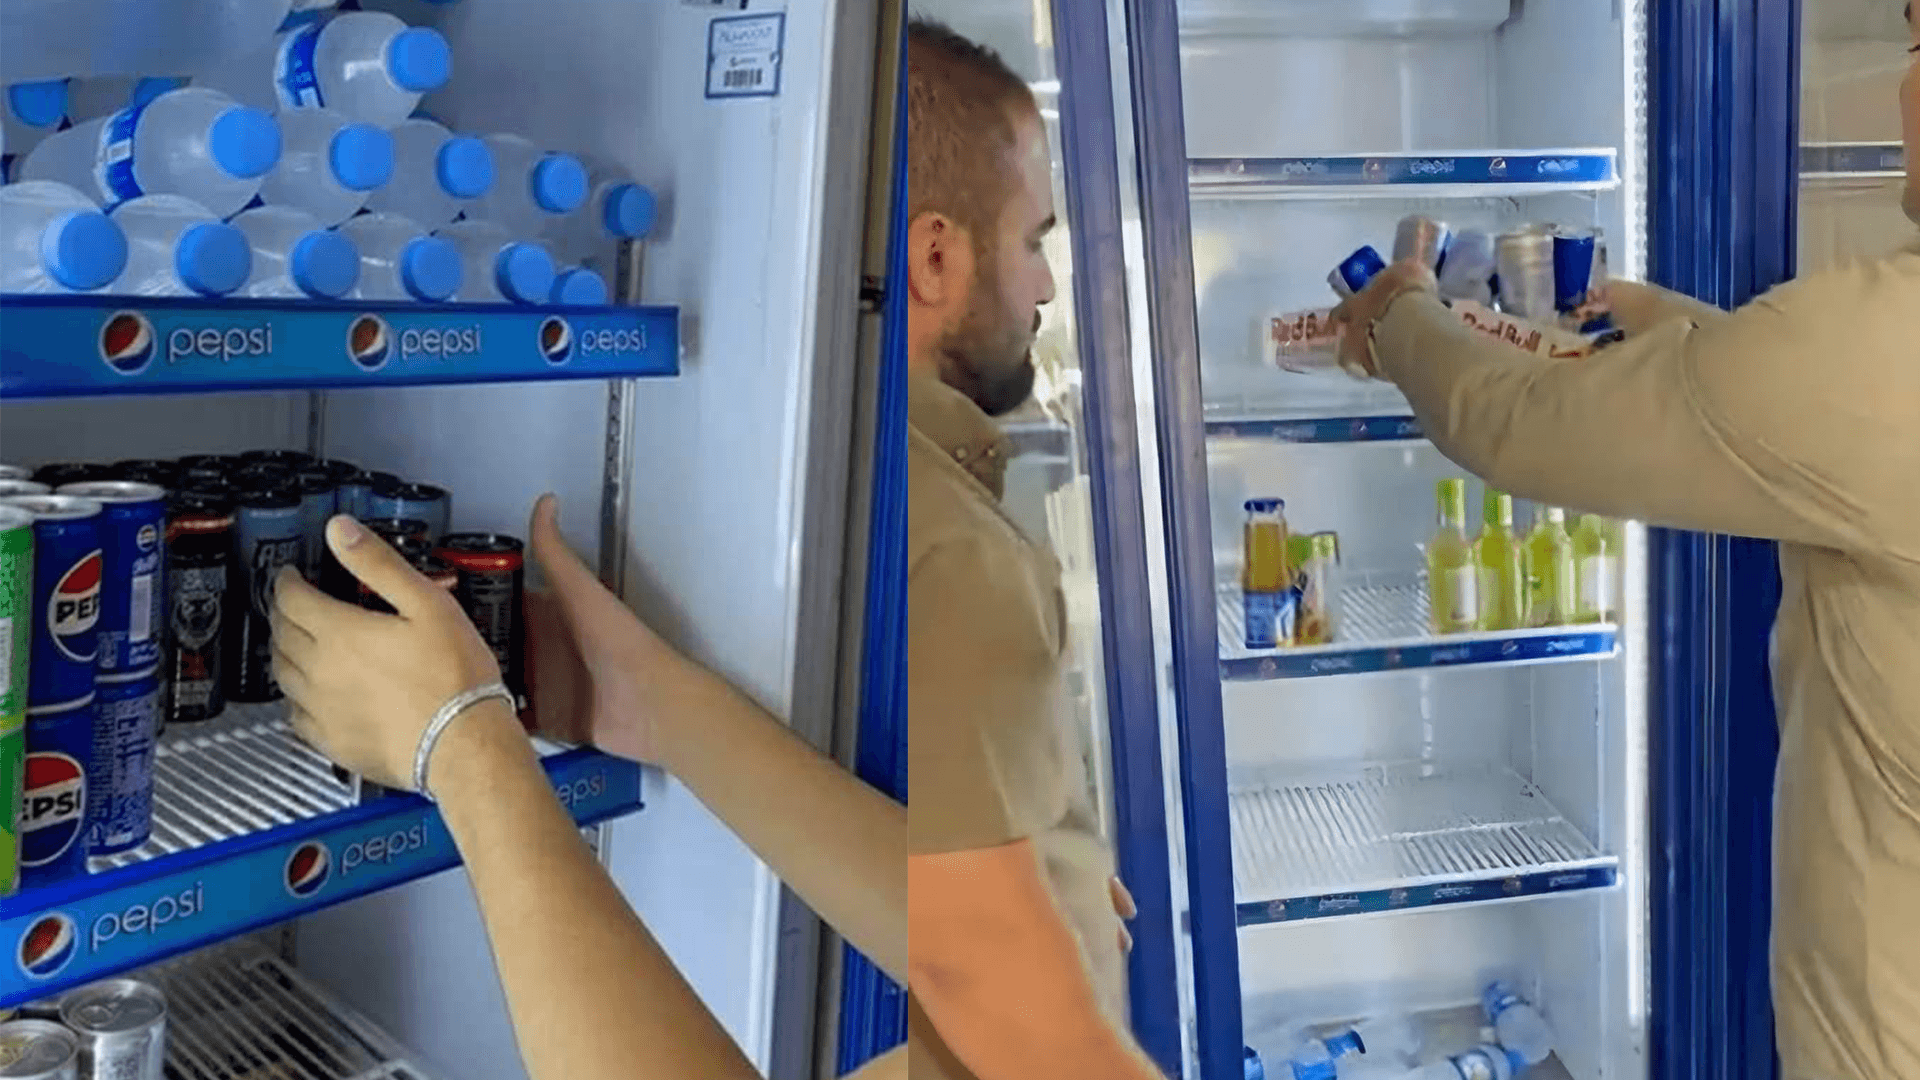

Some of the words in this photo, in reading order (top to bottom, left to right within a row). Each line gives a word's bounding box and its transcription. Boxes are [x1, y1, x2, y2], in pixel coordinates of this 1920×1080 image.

[169, 322, 273, 363] pepsi
[401, 323, 482, 359] pepsi
[580, 324, 648, 356] pepsi
[91, 881, 205, 952] pepsi
[341, 823, 429, 875] pepsi
[555, 774, 606, 807] epsi
